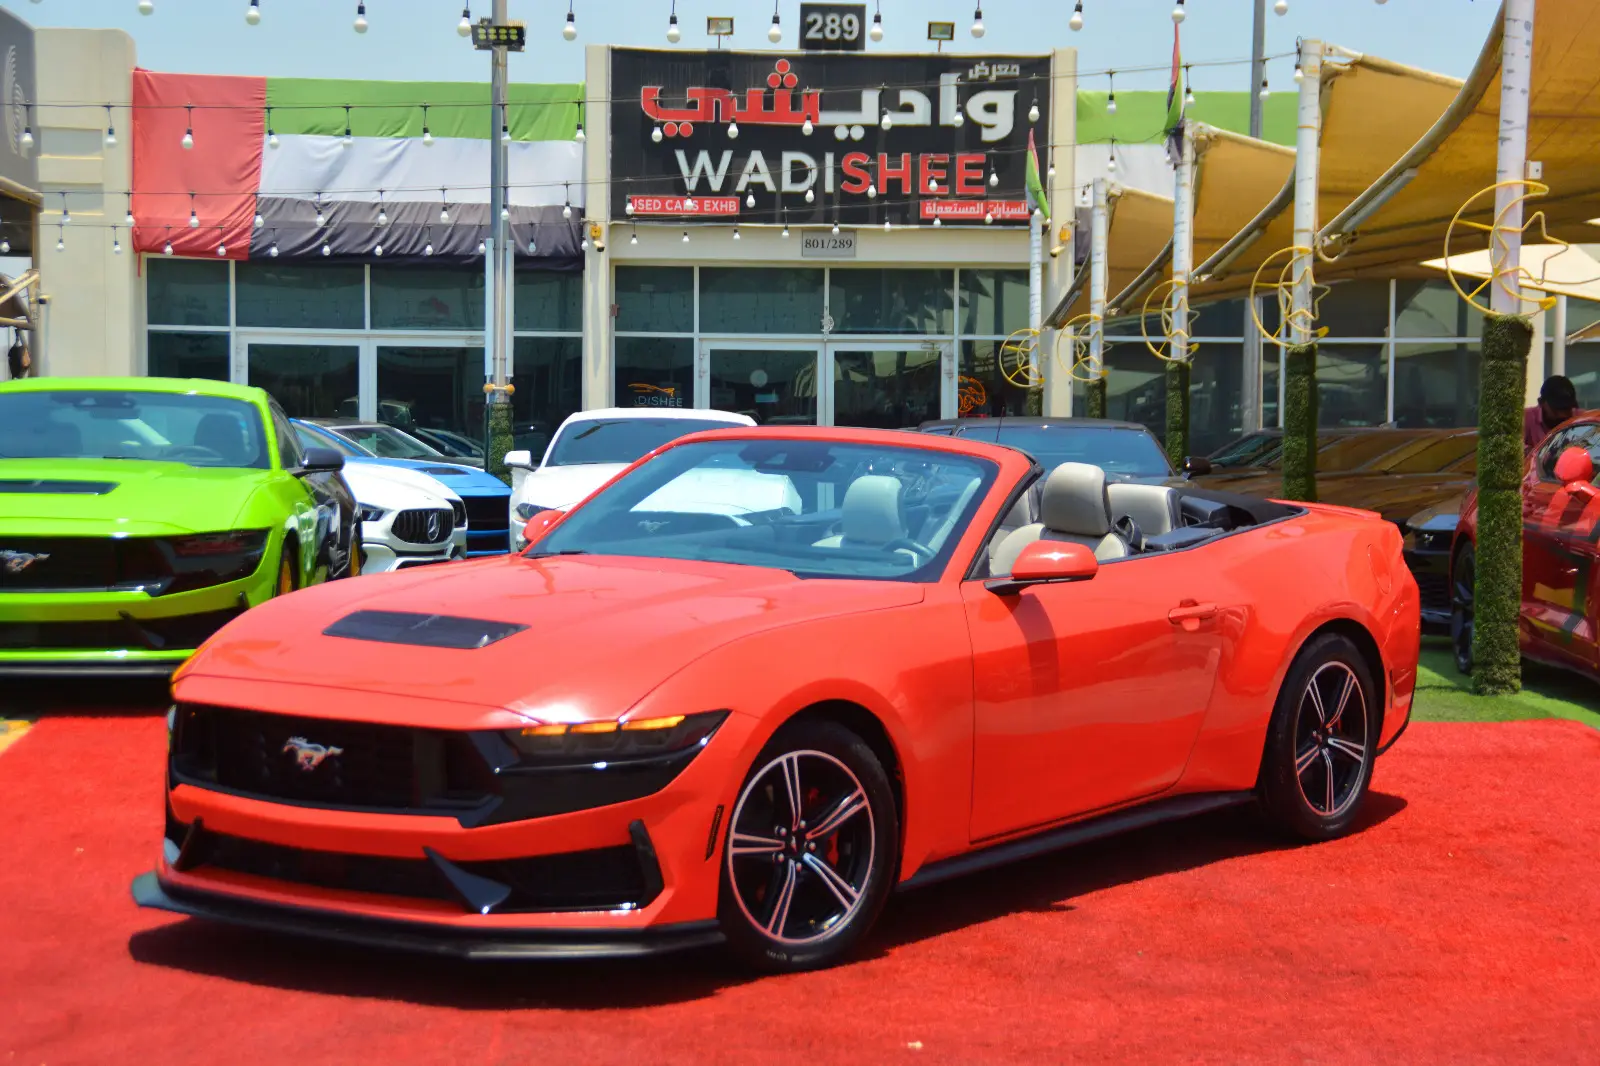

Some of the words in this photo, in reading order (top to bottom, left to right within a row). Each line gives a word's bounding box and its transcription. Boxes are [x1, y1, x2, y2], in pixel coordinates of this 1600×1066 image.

[805, 12, 860, 41] 289
[968, 61, 1020, 83] معرض
[674, 149, 986, 195] WADISHEE
[703, 201, 737, 213] EXHB
[925, 202, 984, 215] المستعملة
[805, 239, 853, 249] 801/289
